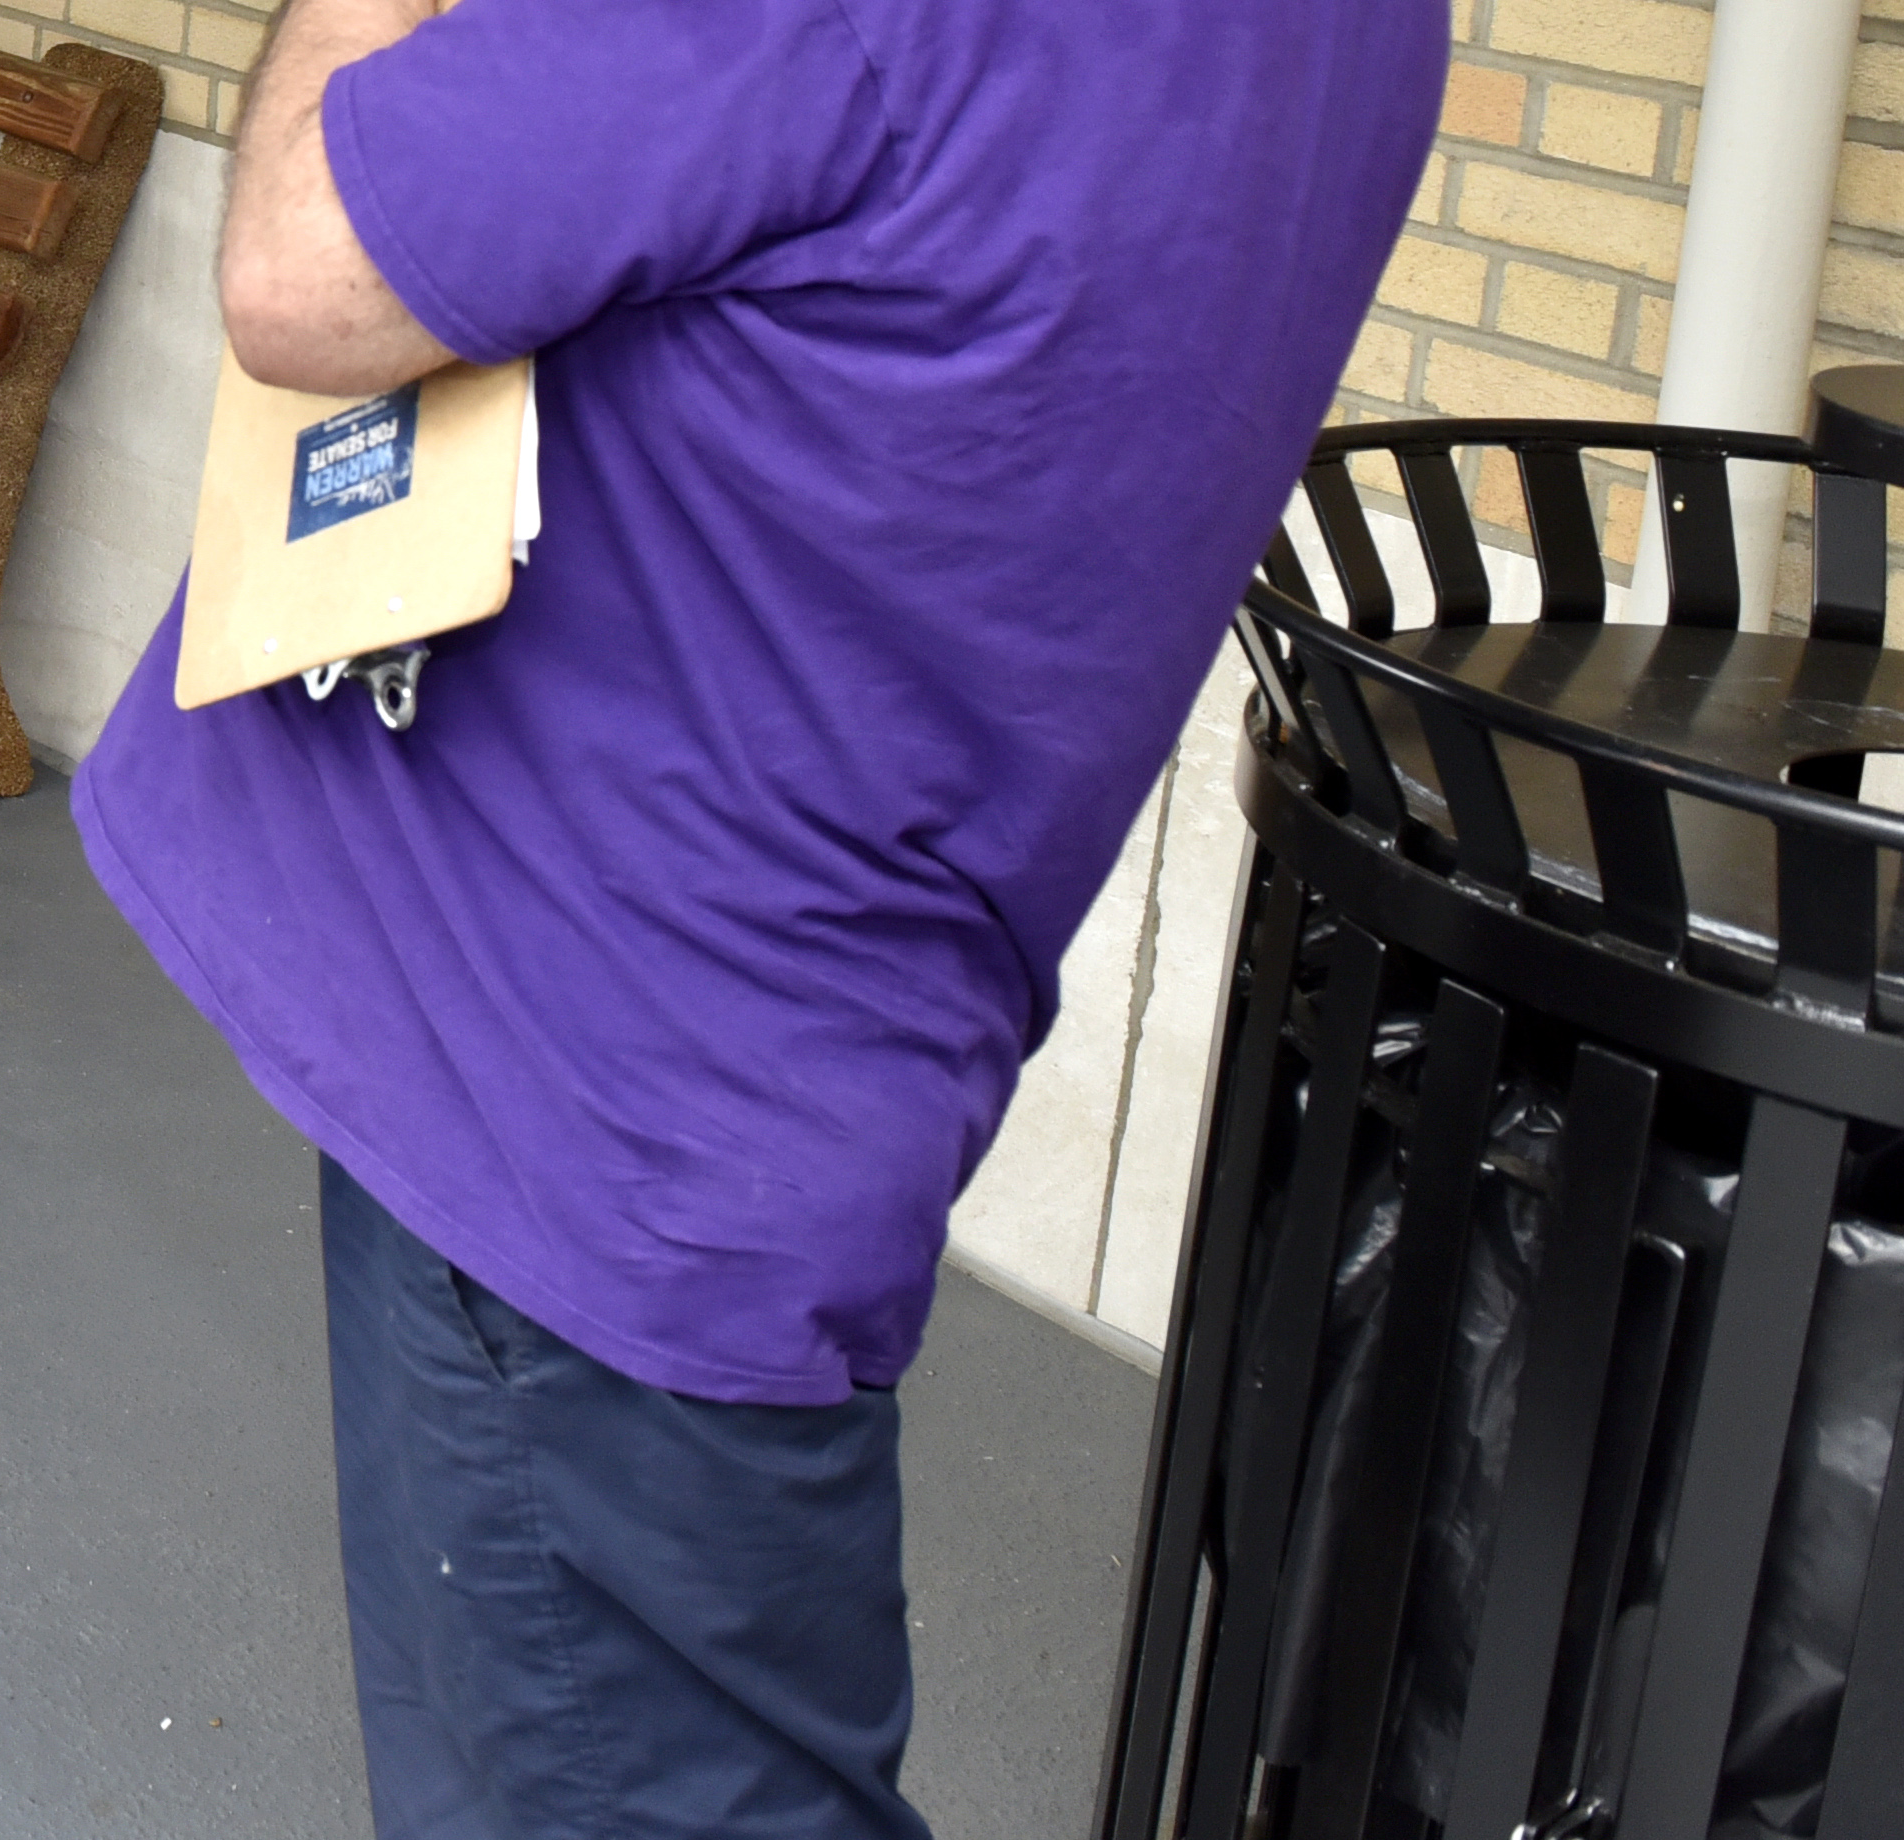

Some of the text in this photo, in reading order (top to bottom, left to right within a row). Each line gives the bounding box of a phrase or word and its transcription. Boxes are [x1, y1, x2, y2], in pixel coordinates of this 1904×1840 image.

[304, 441, 395, 503] WARREN
[307, 416, 399, 473] FOR SENATE
